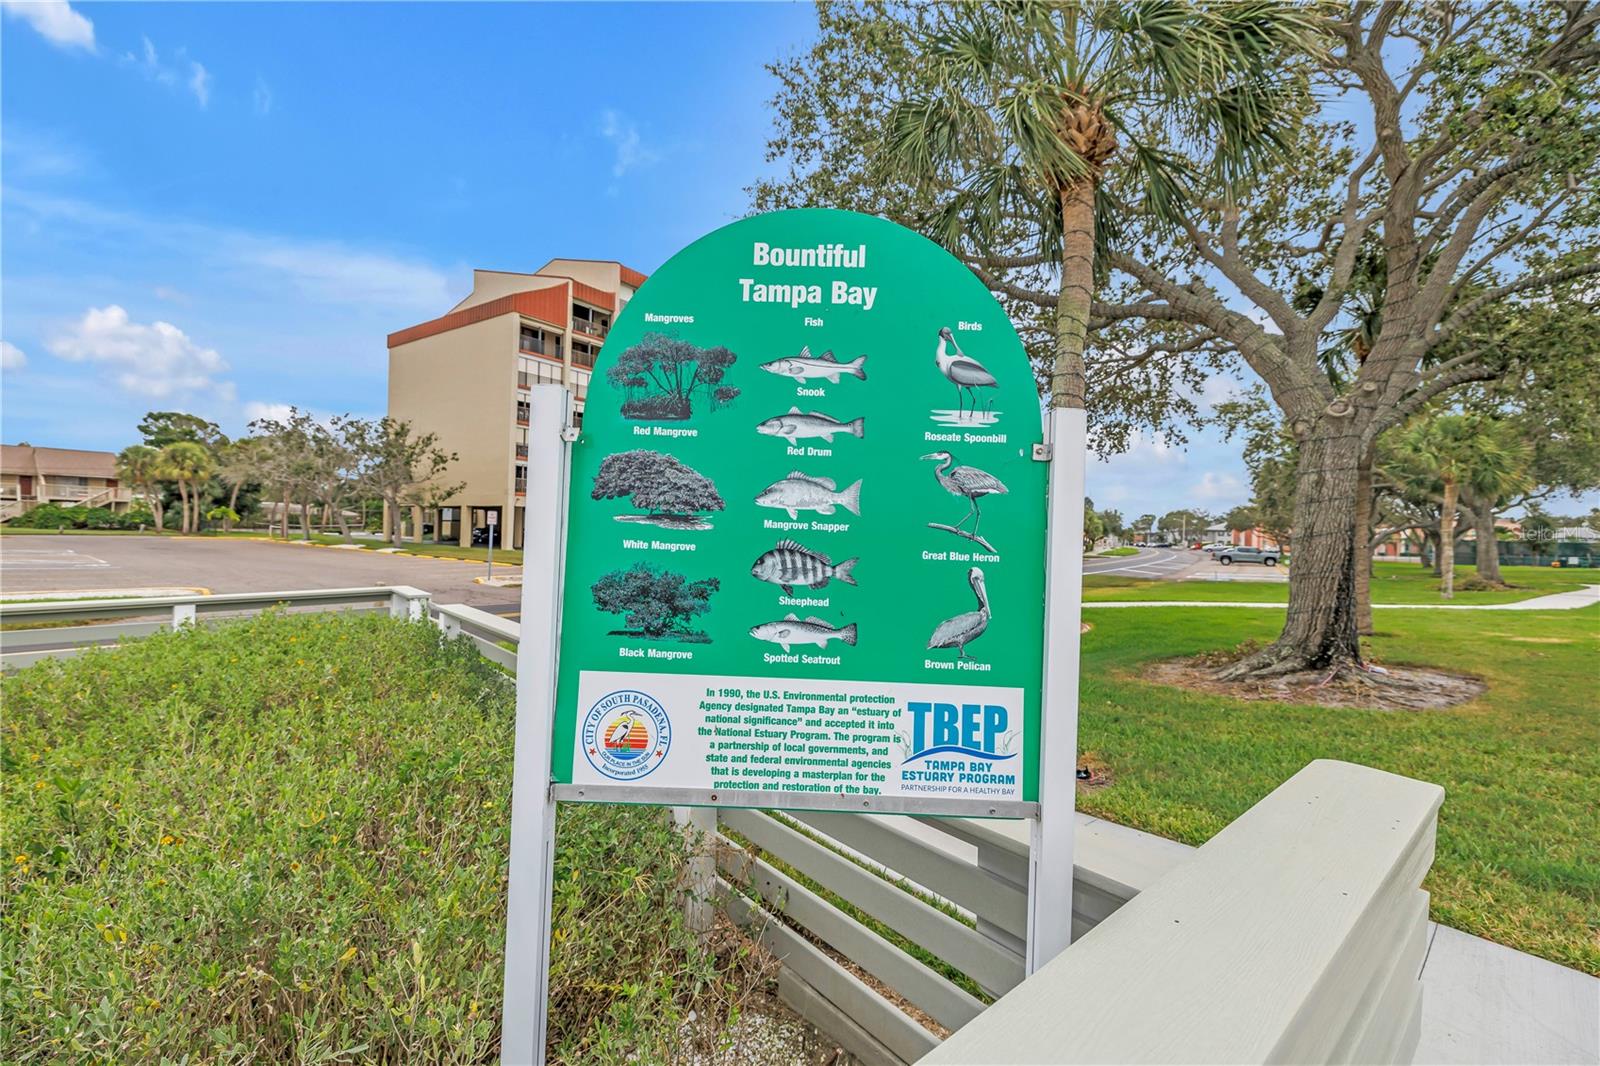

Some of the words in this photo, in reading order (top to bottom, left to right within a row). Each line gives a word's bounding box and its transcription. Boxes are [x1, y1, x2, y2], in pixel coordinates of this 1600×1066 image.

[753, 242, 866, 268] Bountiful
[739, 278, 822, 308] Tampa
[831, 280, 877, 310] Bay
[645, 313, 694, 324] Mangroves
[804, 317, 824, 327] Fish
[958, 321, 982, 331] Birds
[796, 387, 825, 397] Snook
[634, 426, 651, 437] Red
[655, 426, 698, 439] Mangrove
[924, 432, 961, 443] Roseate
[963, 433, 1007, 446] Spoonbill
[787, 446, 805, 457] Red
[807, 447, 832, 458] Drum
[763, 519, 808, 532] Mangrove
[811, 521, 849, 534] Snapper
[623, 539, 649, 551] White
[651, 540, 696, 553] Mangrove
[922, 551, 946, 562] Great
[949, 551, 970, 562] Blue
[972, 552, 1000, 564] Heron
[778, 596, 830, 608] Sheephead
[619, 648, 646, 659] Black
[648, 648, 693, 662] Mangrove
[763, 653, 799, 666] Spotted
[802, 654, 841, 666] Seatrout
[924, 660, 956, 670] Brown
[958, 660, 991, 672] Pelican
[706, 688, 715, 697] In
[718, 689, 743, 699] 1990,
[747, 690, 760, 698] the
[764, 690, 780, 699] U.S.
[784, 691, 847, 701] Environmental
[850, 694, 895, 704] protection
[699, 702, 732, 712] Agency
[735, 703, 784, 713] designated
[787, 705, 815, 715] Tampa
[819, 706, 835, 716] Bay
[852, 708, 889, 718] “estuary
[893, 709, 901, 717] of
[586, 721, 595, 744] CITY
[592, 708, 603, 720] OF
[602, 694, 630, 711] SOUTH
[659, 735, 668, 746] FL
[705, 715, 741, 724] national
[744, 716, 802, 727] significance”
[806, 718, 822, 727] and
[825, 720, 865, 730] accepted
[869, 721, 874, 729] it
[878, 721, 894, 730] into
[698, 727, 712, 736] the
[715, 728, 751, 737] National
[754, 730, 787, 740] Estuary
[790, 731, 831, 742] Program.
[834, 732, 849, 741] The
[852, 734, 890, 743] program
[894, 734, 901, 743] is
[908, 702, 1008, 754] TBEP
[718, 741, 769, 752] partnership
[772, 743, 781, 751] of
[784, 743, 805, 752] local
[808, 745, 868, 755] governments,
[872, 746, 888, 755] and
[706, 754, 728, 762] state
[731, 755, 747, 763] and
[750, 756, 781, 764] federal
[784, 758, 848, 767] environmental
[851, 760, 891, 769] agencies
[925, 760, 965, 771] TAMPA
[970, 762, 992, 771] BAY
[602, 763, 636, 776] Incorporated
[711, 767, 729, 775] that
[732, 768, 739, 776] is
[742, 768, 791, 779] developing
[802, 770, 852, 781] masterplan
[856, 773, 868, 781] for
[871, 773, 885, 782] the
[902, 771, 954, 781] ESTUARY
[959, 775, 1015, 784] PROGRAM
[714, 781, 759, 789] protection
[762, 781, 779, 790] and
[782, 783, 831, 791] restoration
[834, 784, 843, 792] of
[846, 785, 860, 793] the
[863, 786, 881, 795] bay.
[901, 784, 946, 792] PARTNERSHIP
